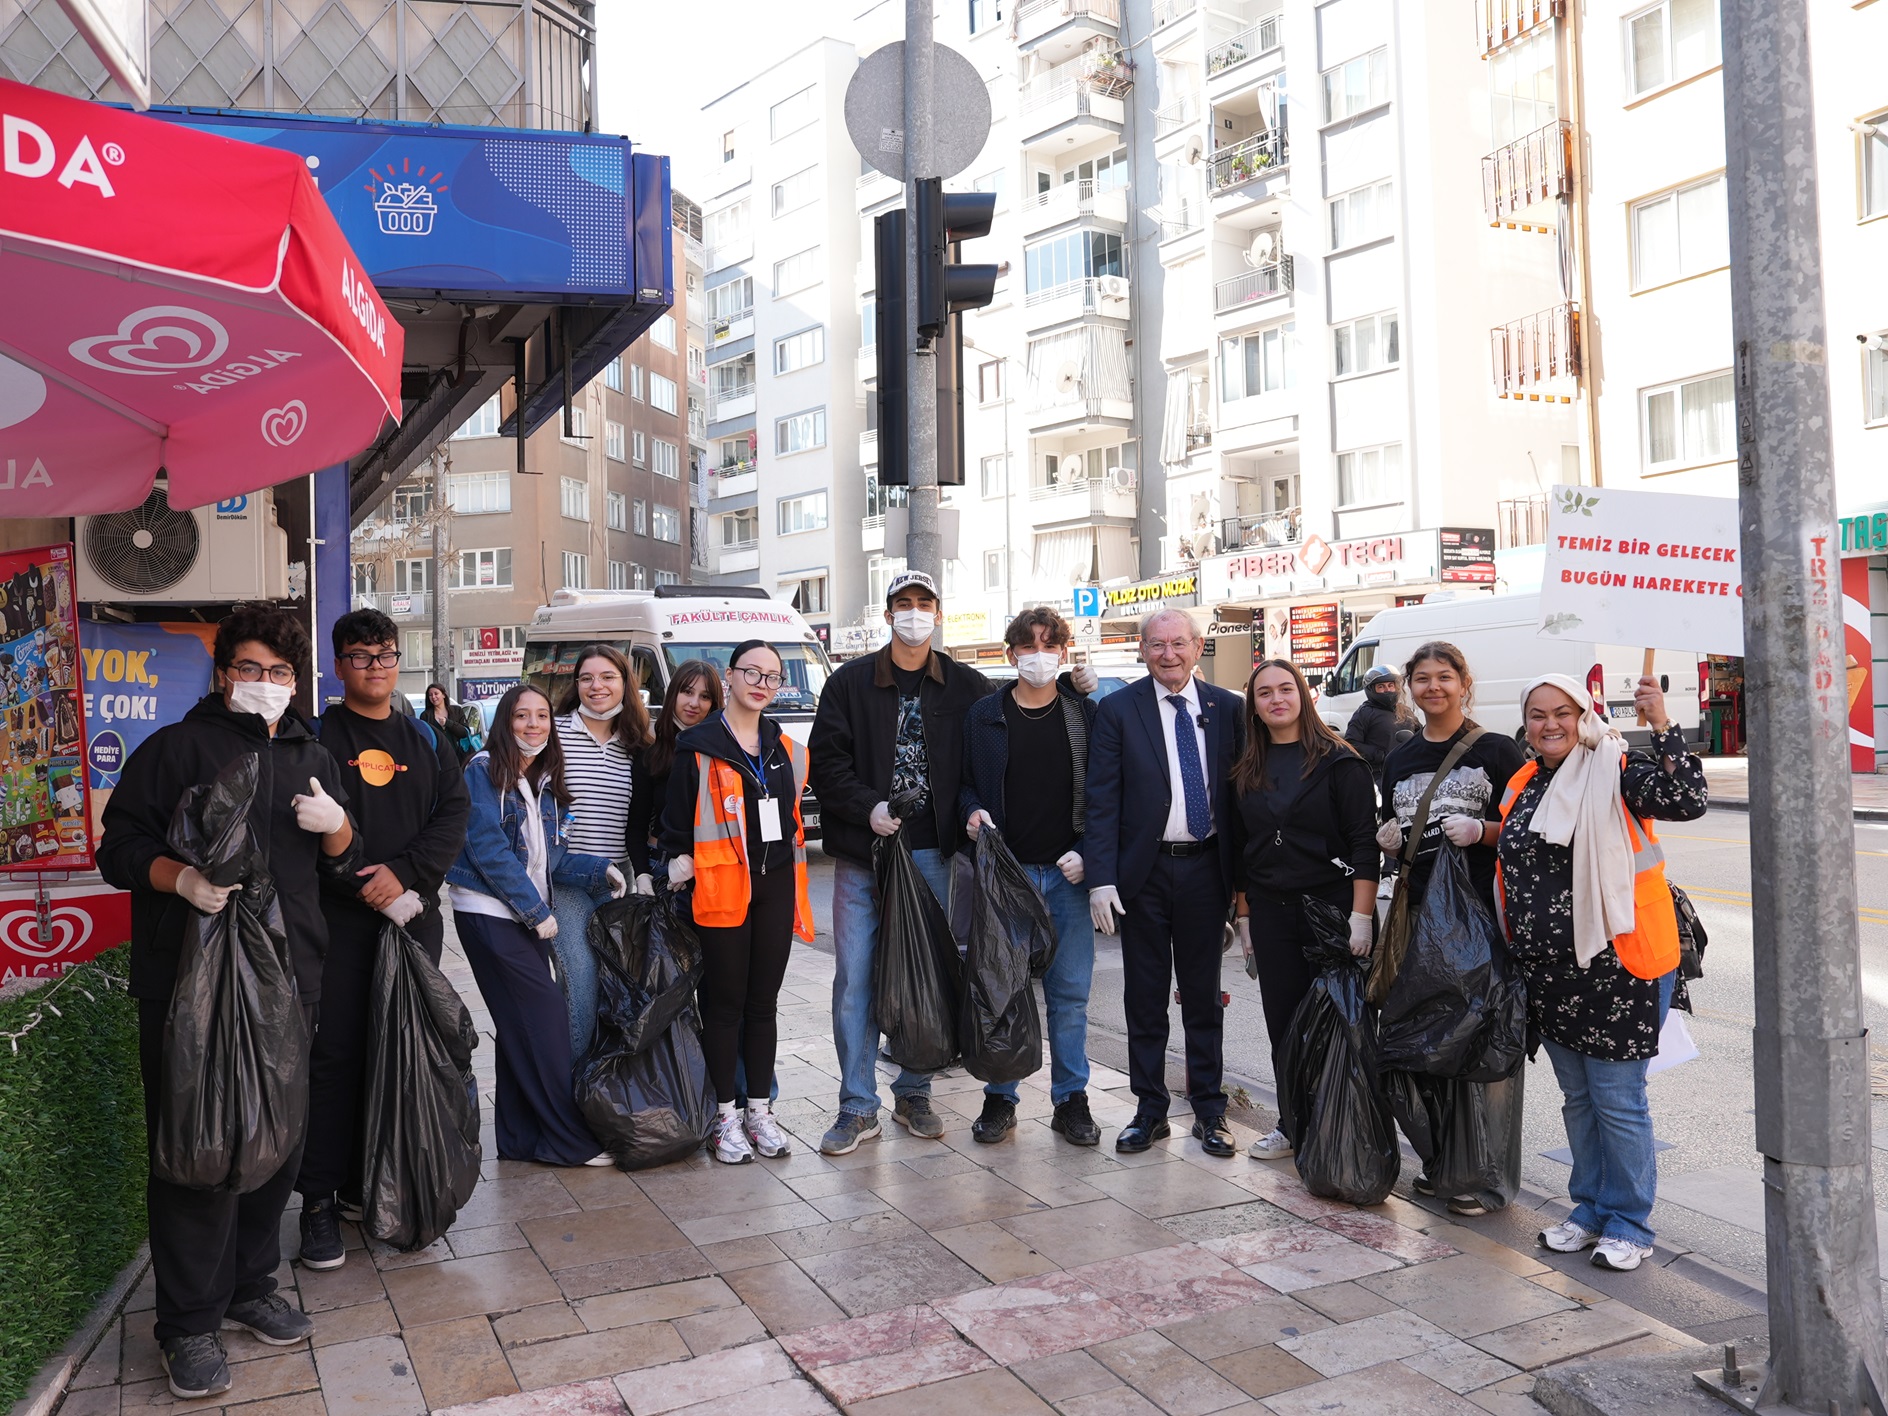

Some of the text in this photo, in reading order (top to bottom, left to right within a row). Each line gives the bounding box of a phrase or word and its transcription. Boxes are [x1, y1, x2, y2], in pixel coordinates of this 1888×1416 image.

[1227, 537, 1403, 579] FIBER TECH
[1558, 536, 1736, 562] TEMİZ BİR GELECEK
[1139, 583, 1161, 601] OTO
[1561, 569, 1627, 587] BUGÜN
[1633, 575, 1730, 597] HAREKETE
[1078, 590, 1094, 615] P
[671, 609, 792, 624] FAKÜLTE ÇAMLIK
[1207, 622, 1252, 635] Pionee
[81, 648, 159, 689] YOK,
[100, 694, 158, 724] ÇOK!
[94, 745, 120, 755] HEDİYE
[96, 754, 117, 763] PARA
